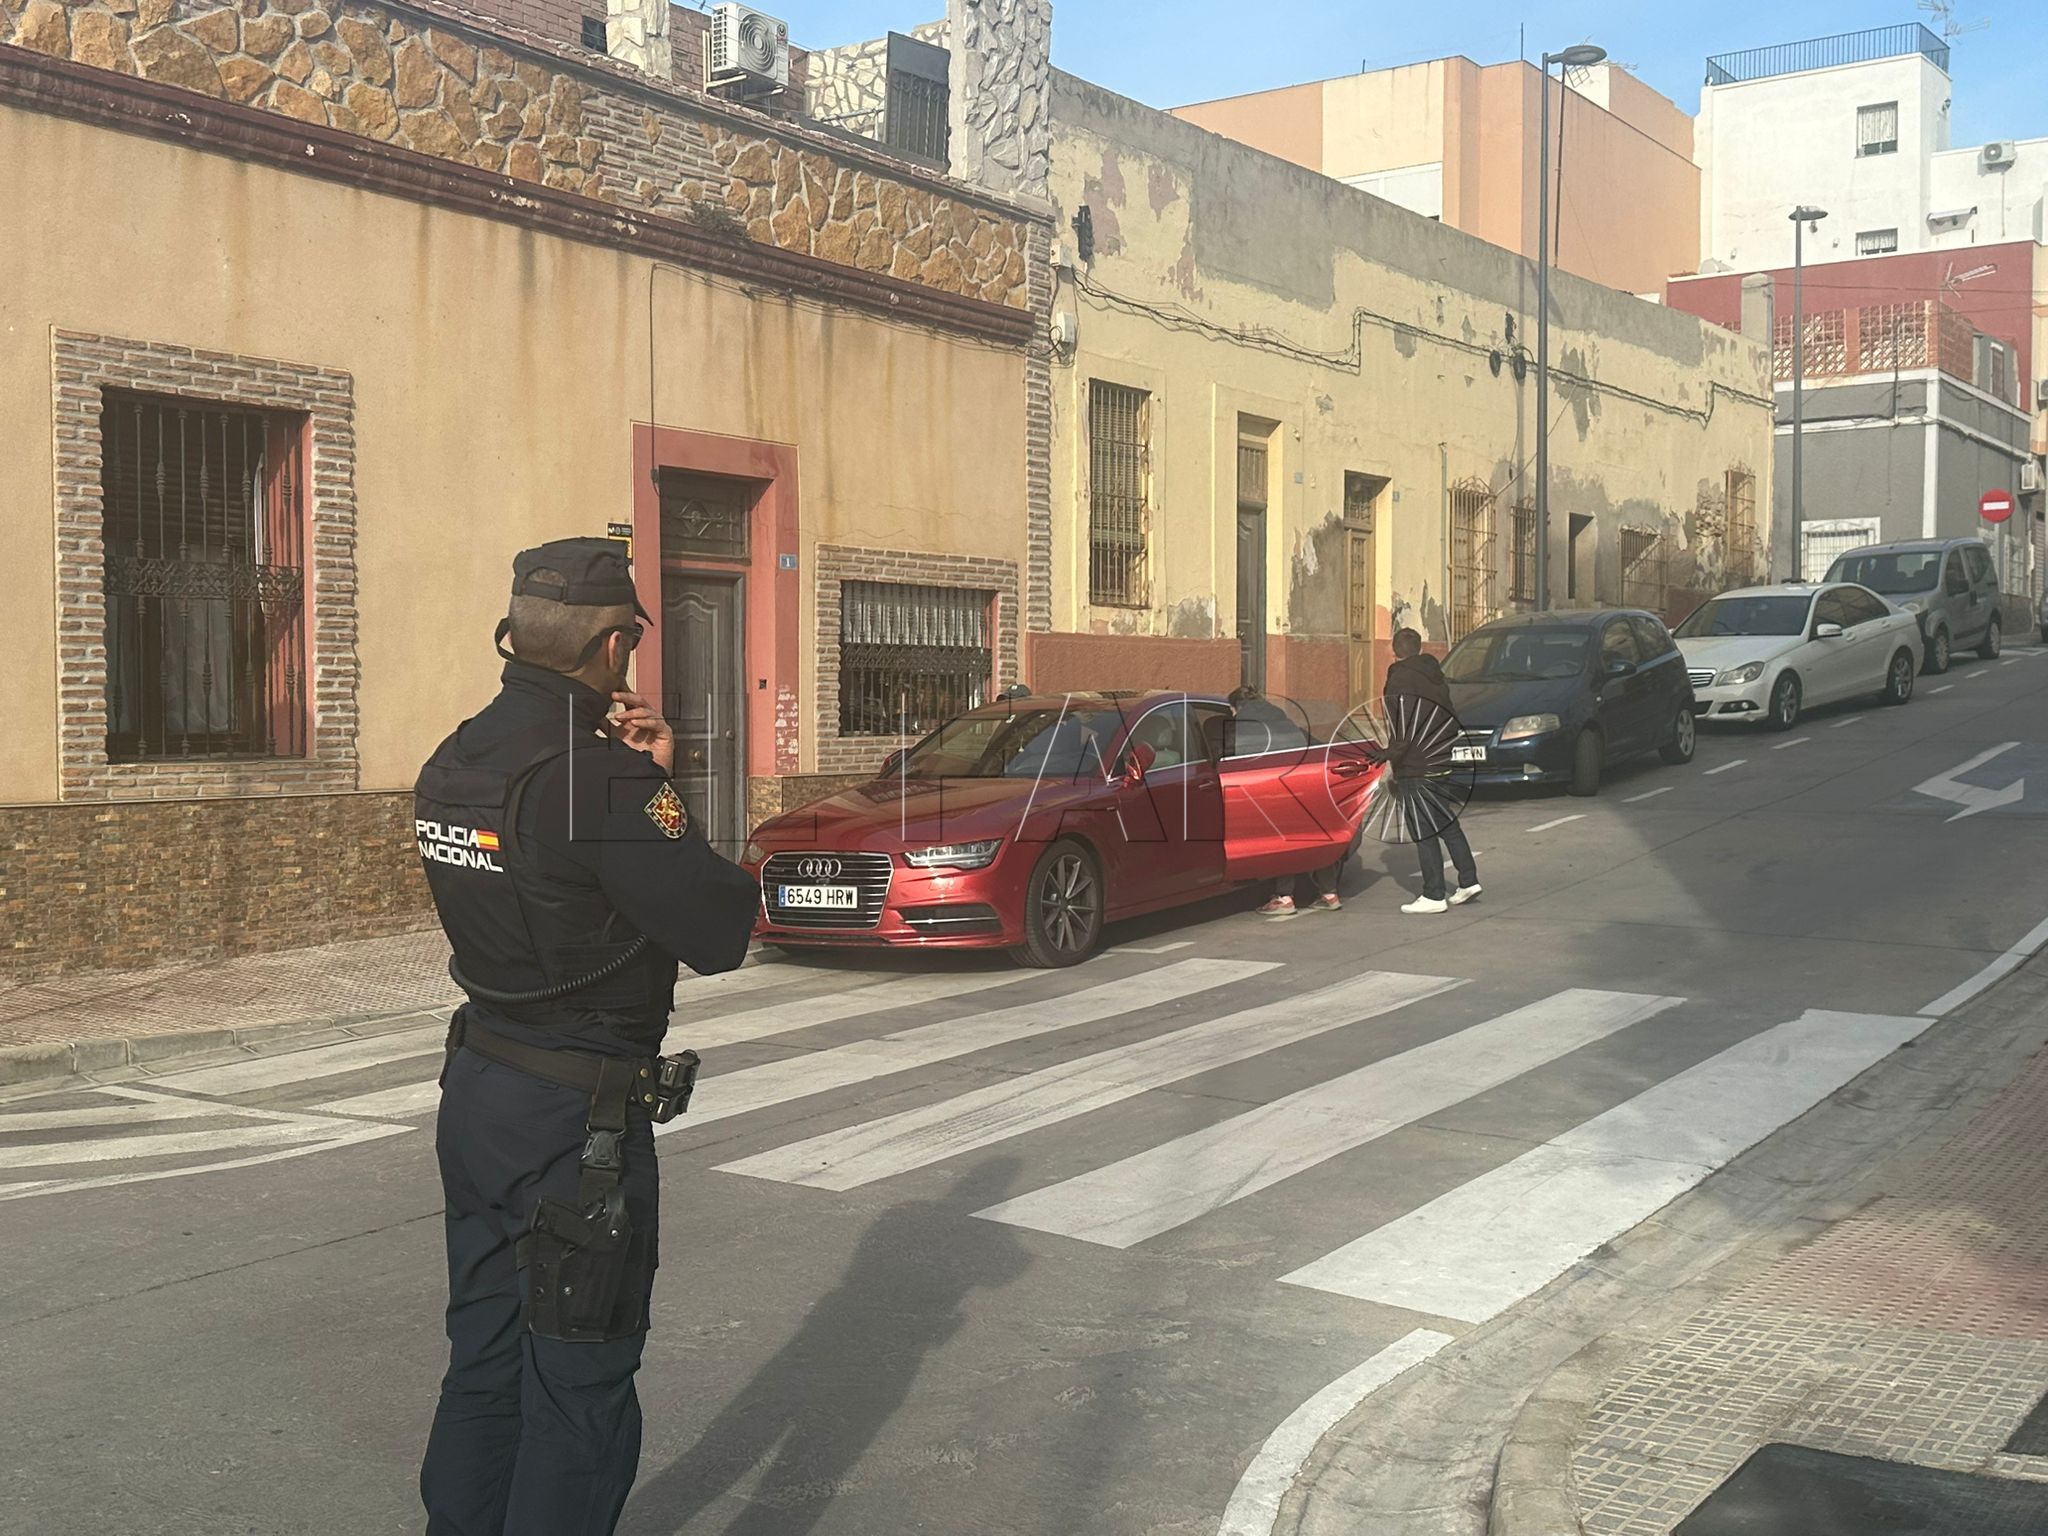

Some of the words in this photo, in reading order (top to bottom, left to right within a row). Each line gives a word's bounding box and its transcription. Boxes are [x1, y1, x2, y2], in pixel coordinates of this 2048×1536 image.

[415, 819, 481, 849] POLICIA
[418, 840, 504, 873] NACIONAL
[787, 888, 822, 905] 6549
[826, 888, 854, 905] HRW
